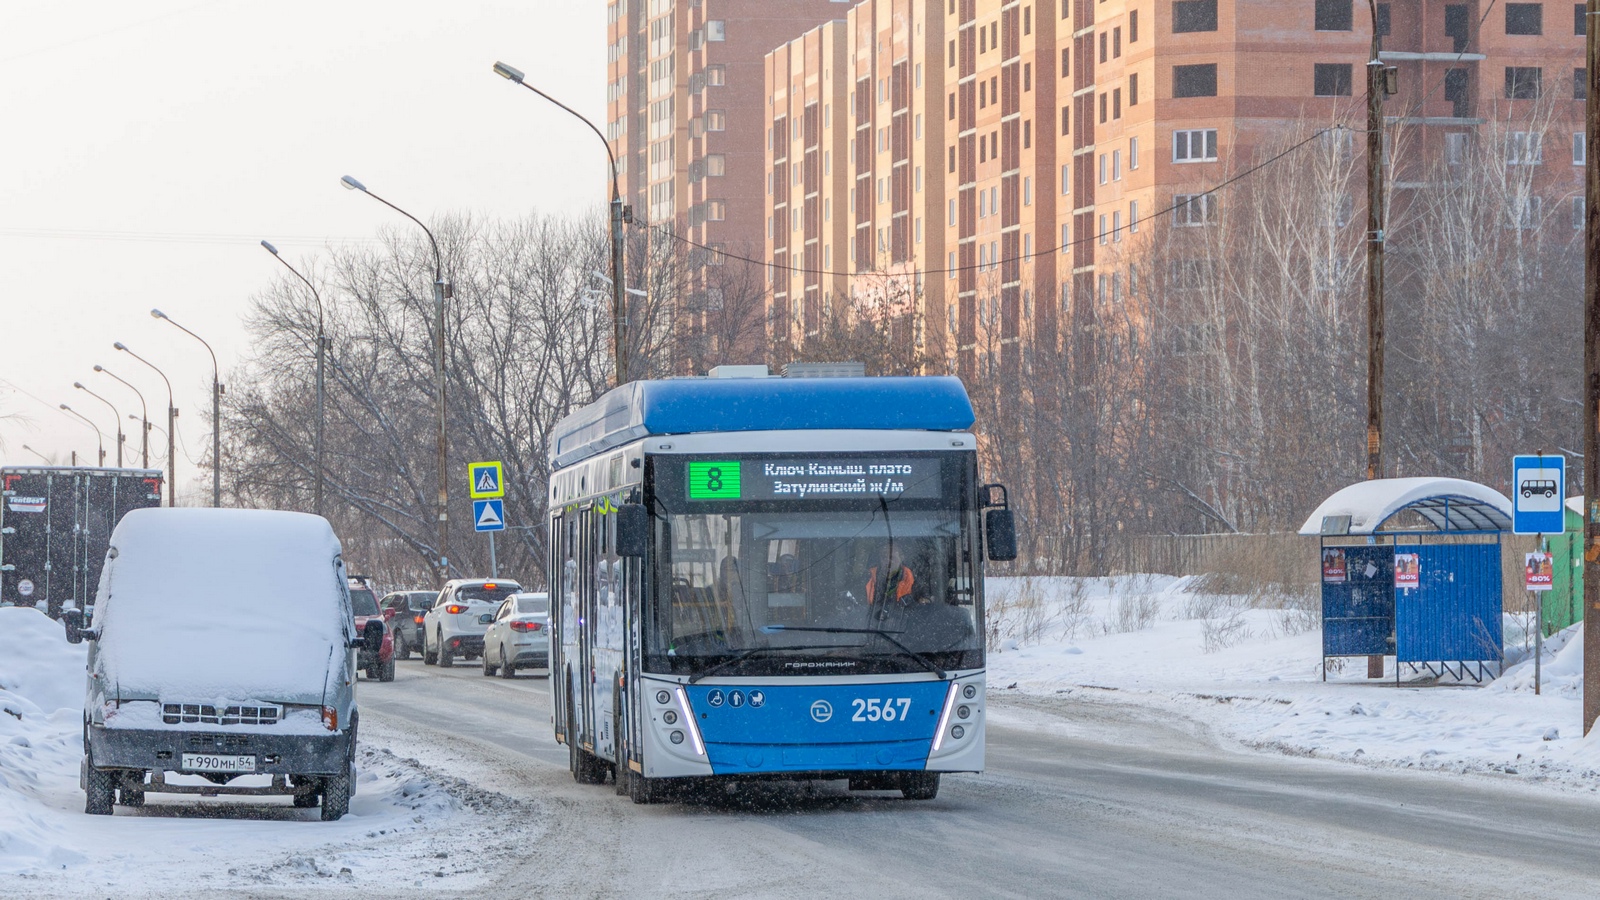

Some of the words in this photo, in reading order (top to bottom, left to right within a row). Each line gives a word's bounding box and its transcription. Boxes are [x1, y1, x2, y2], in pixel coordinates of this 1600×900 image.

[707, 467, 723, 491] 8
[764, 463, 866, 476] Ключ-Камыш.
[869, 464, 912, 475] плато
[774, 478, 866, 497] Затулинский
[869, 478, 904, 495] ж/м
[851, 698, 912, 722] 2567
[238, 757, 251, 766] 54
